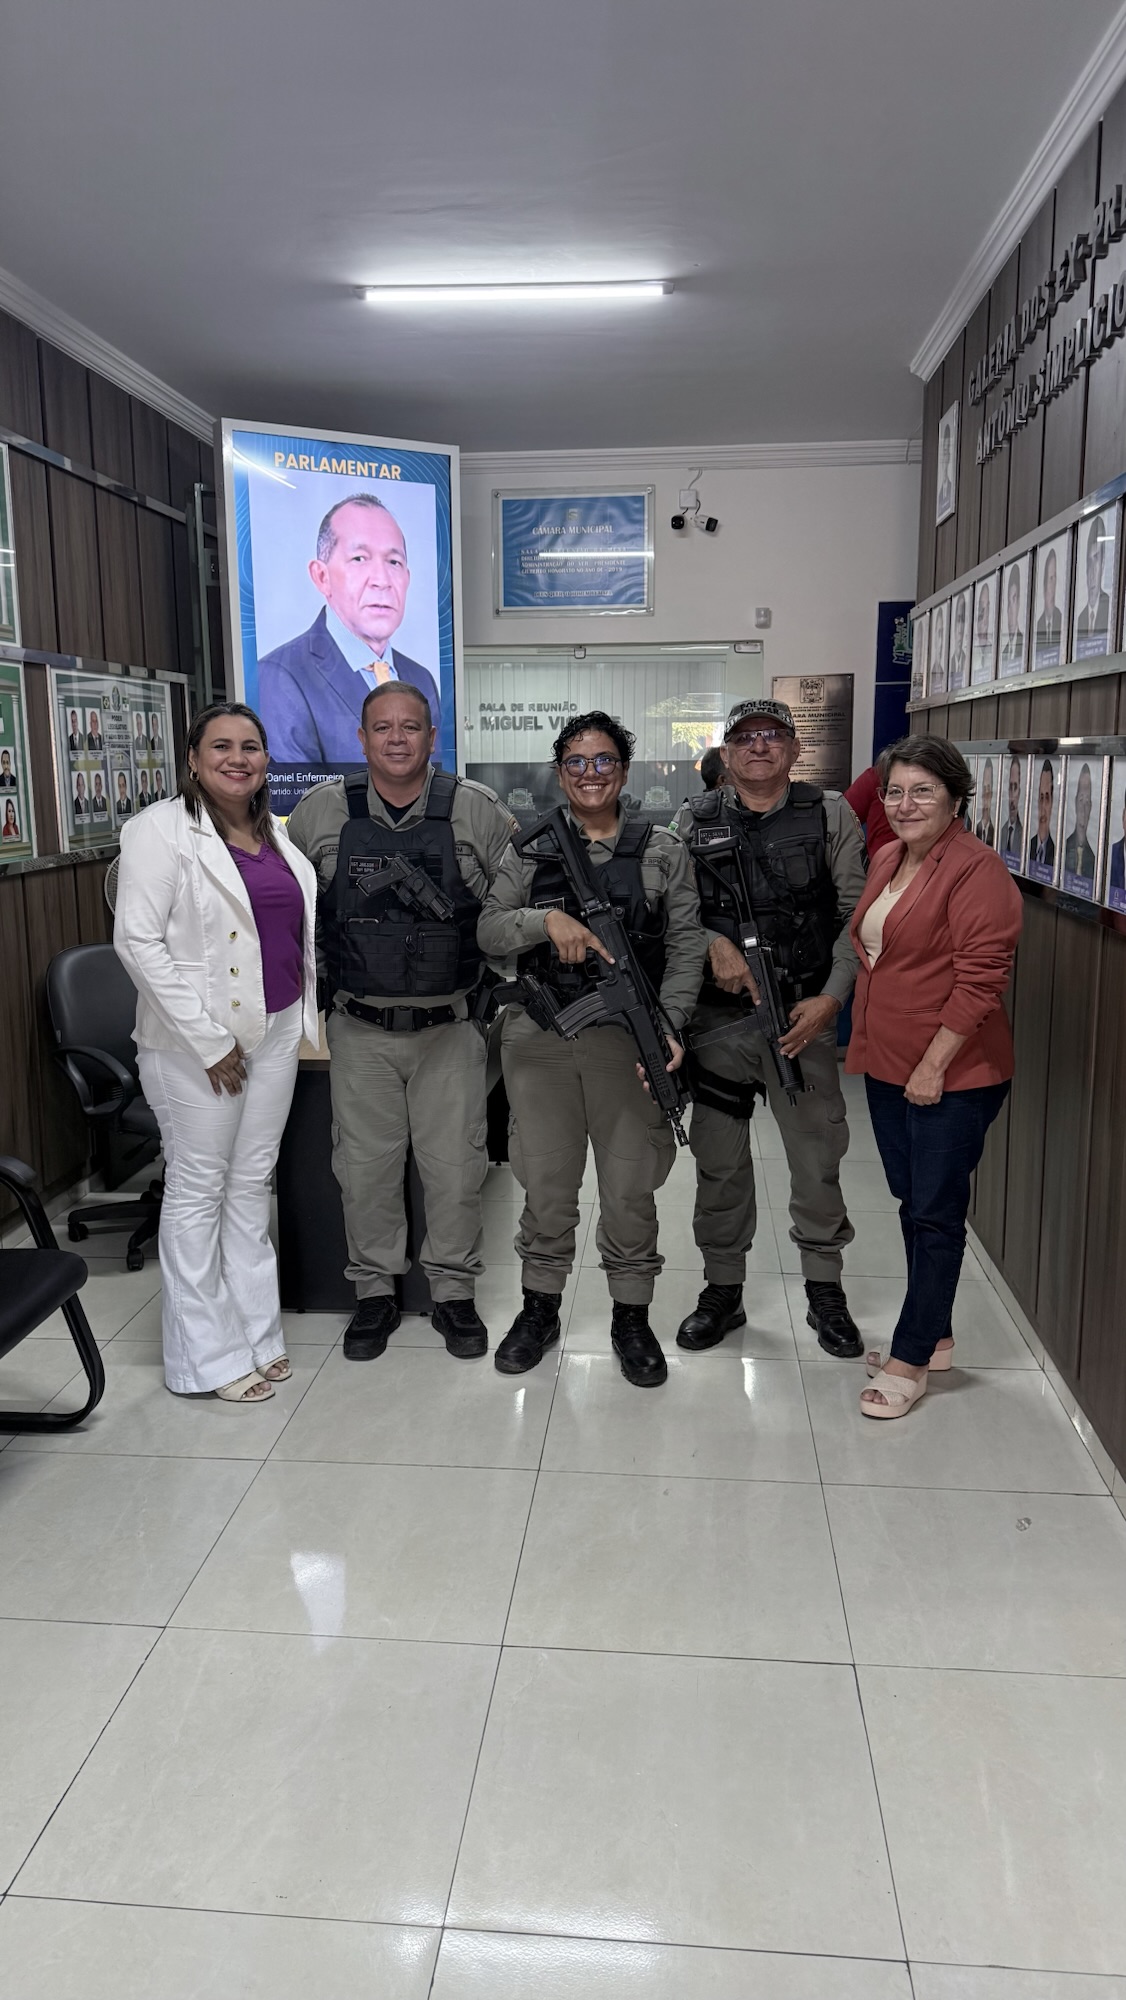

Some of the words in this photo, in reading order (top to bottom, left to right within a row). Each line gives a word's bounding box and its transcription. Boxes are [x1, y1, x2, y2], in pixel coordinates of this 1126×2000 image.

[968, 314, 1021, 408] GALERIA
[1020, 271, 1053, 346] DOS
[274, 451, 401, 480] PARLAMENTAR
[532, 525, 566, 535] CÂMARA
[568, 525, 614, 535] MUNICIPAL
[479, 702, 506, 712] SALA
[510, 702, 524, 712] DE
[528, 700, 578, 712] REUNIÃO
[480, 715, 543, 731] MIGUEL
[266, 772, 295, 782] Daniel
[296, 772, 345, 782] Enfermeiro
